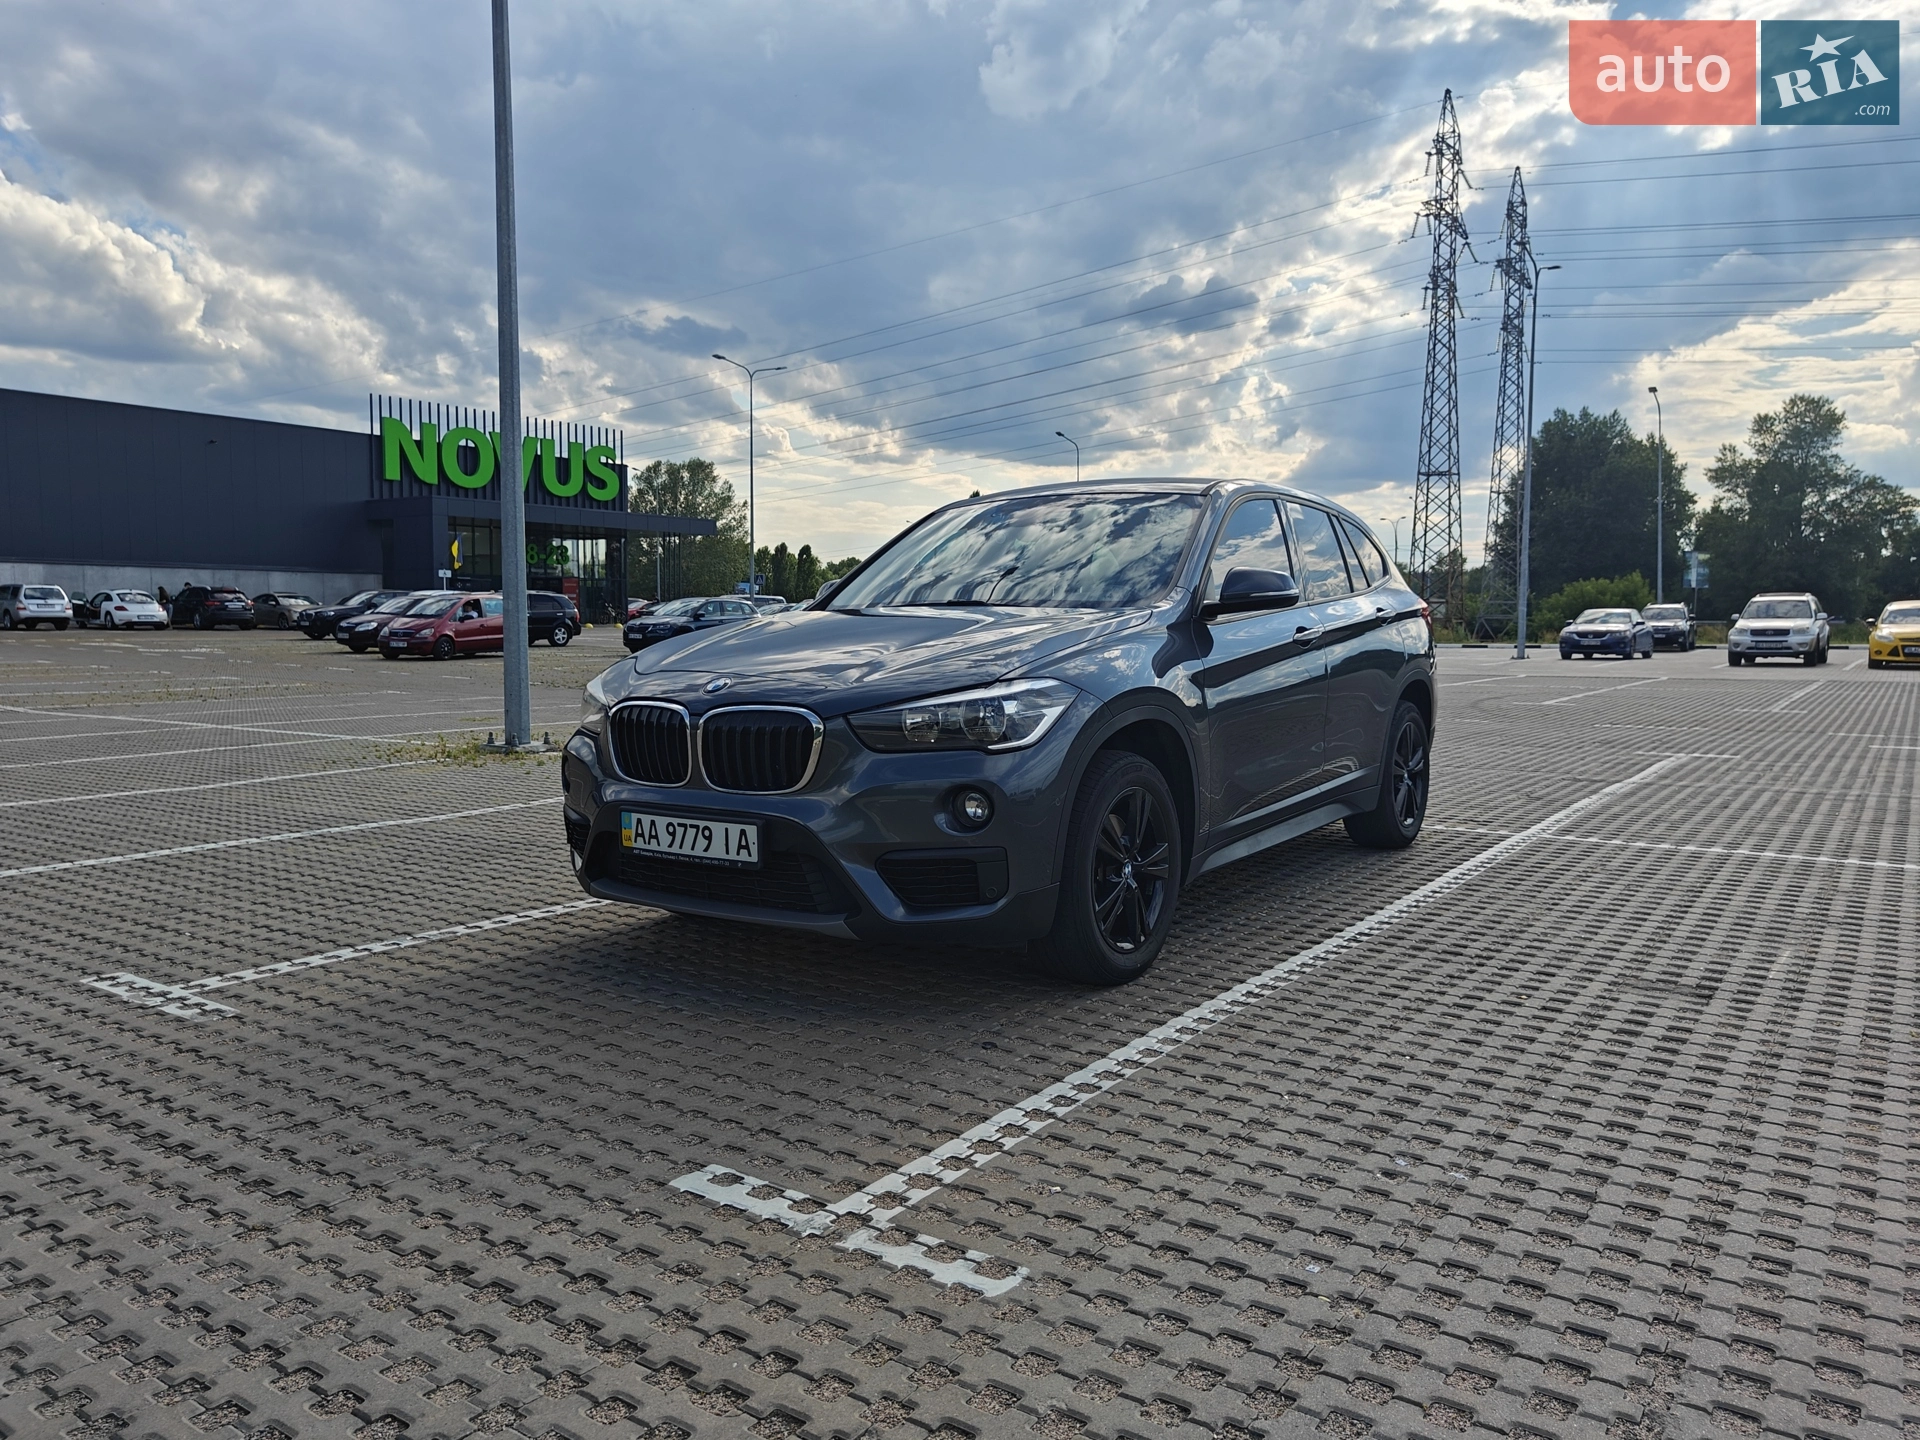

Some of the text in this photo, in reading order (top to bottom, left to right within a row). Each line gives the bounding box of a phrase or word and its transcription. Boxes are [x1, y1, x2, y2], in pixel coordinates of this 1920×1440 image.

[623, 834, 633, 843] UA
[634, 817, 661, 847] AA
[665, 821, 713, 853] 9779
